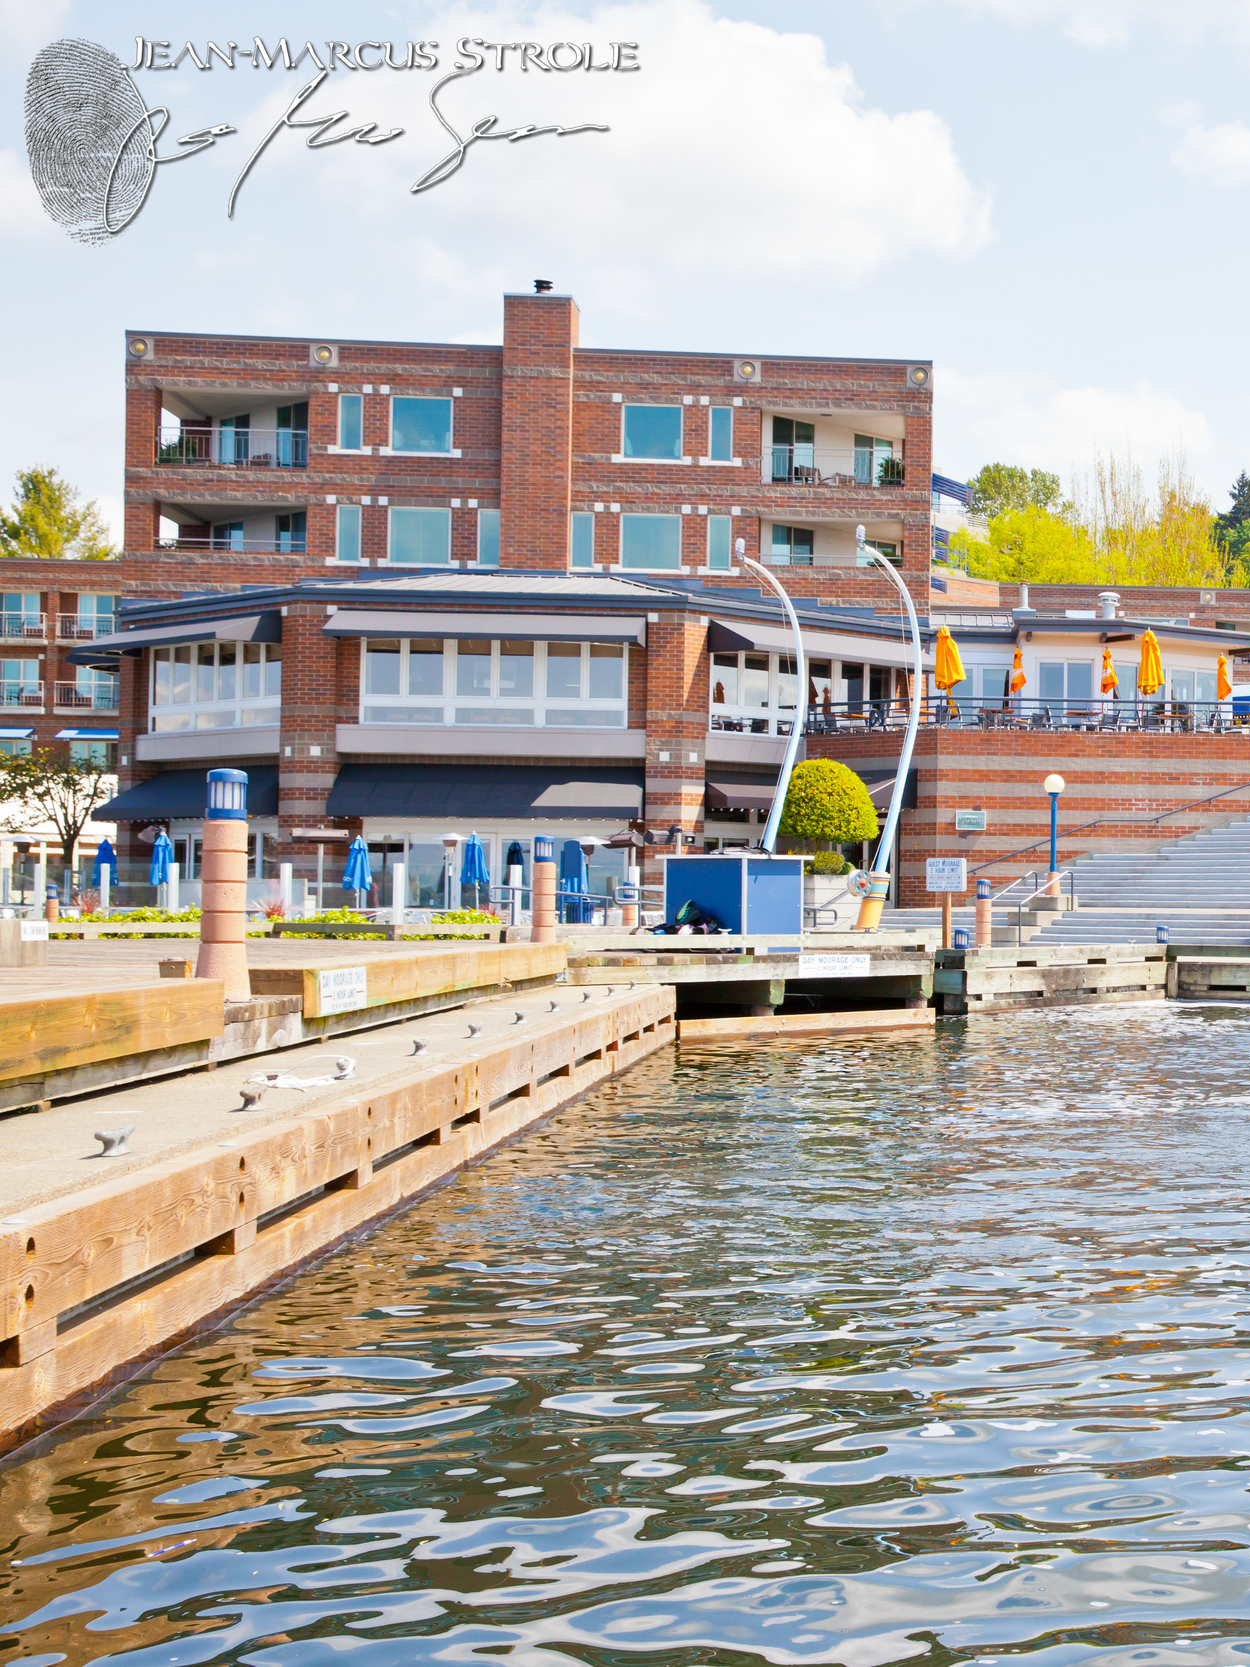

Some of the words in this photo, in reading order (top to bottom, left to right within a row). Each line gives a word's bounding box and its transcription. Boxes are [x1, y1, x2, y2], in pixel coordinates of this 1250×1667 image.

[802, 956, 815, 964] DAY
[818, 956, 849, 964] MOORAGE
[852, 956, 867, 964] ONLY
[333, 972, 353, 987] MOORAGE
